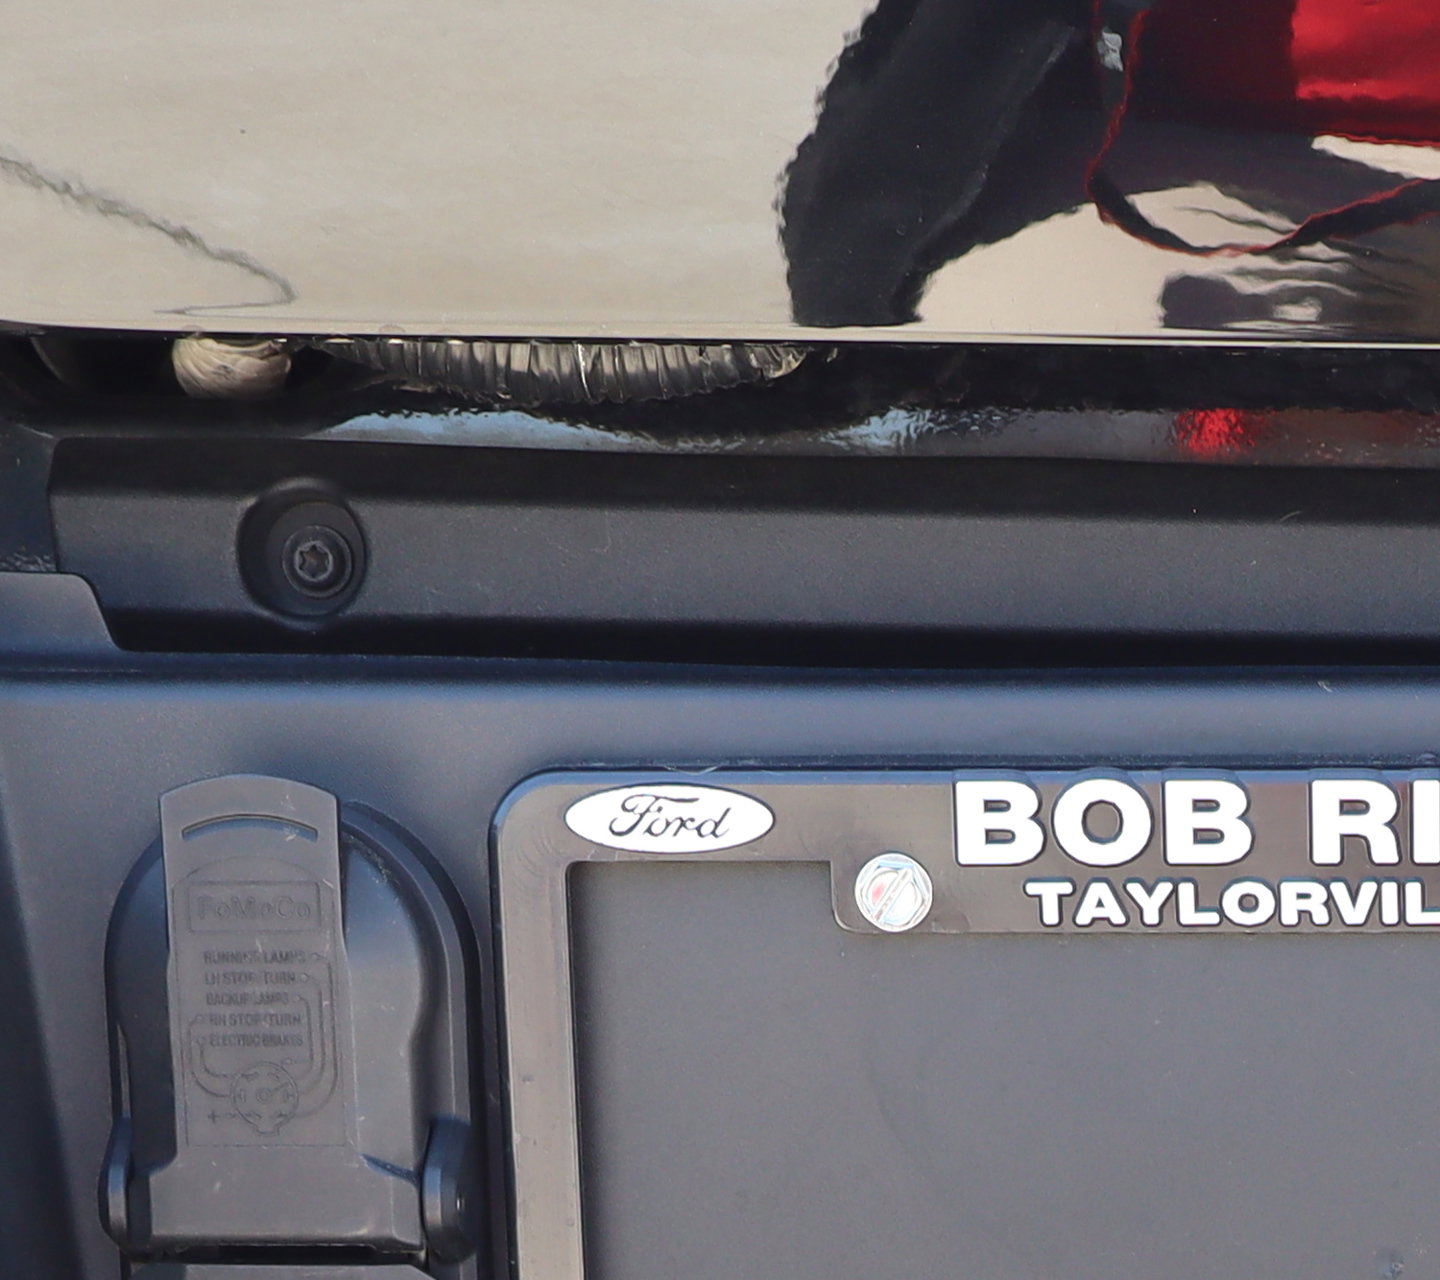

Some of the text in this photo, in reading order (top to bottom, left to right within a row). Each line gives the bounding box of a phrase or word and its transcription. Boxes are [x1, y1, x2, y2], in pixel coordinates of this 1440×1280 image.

[608, 794, 732, 838] Ford
[956, 779, 1252, 866] BOB
[197, 895, 312, 920] FoMoCo
